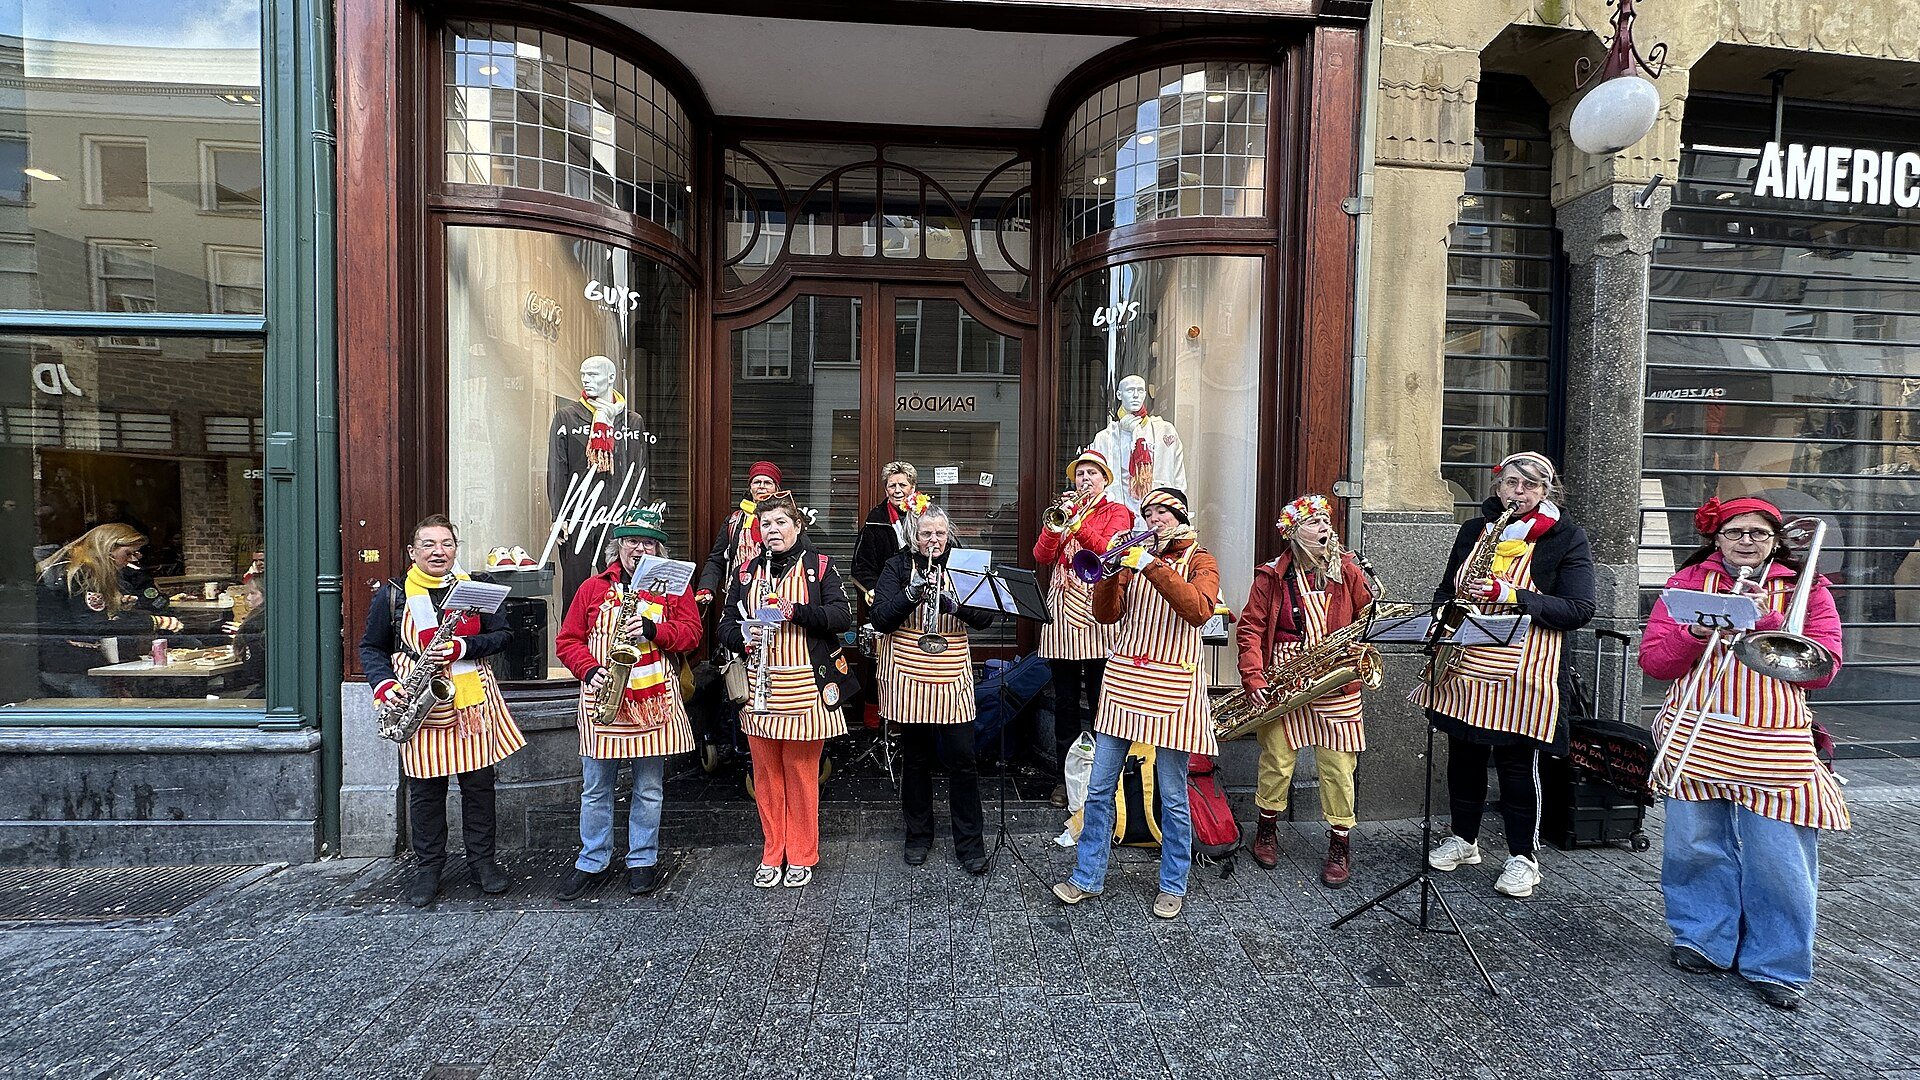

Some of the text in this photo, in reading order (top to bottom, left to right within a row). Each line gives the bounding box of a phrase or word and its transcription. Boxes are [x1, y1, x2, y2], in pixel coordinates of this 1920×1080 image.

[1754, 142, 1920, 208] AMERIC
[584, 279, 641, 311] GUYS
[1092, 301, 1140, 327] GUYS
[556, 424, 658, 445] A NEW HOME TO
